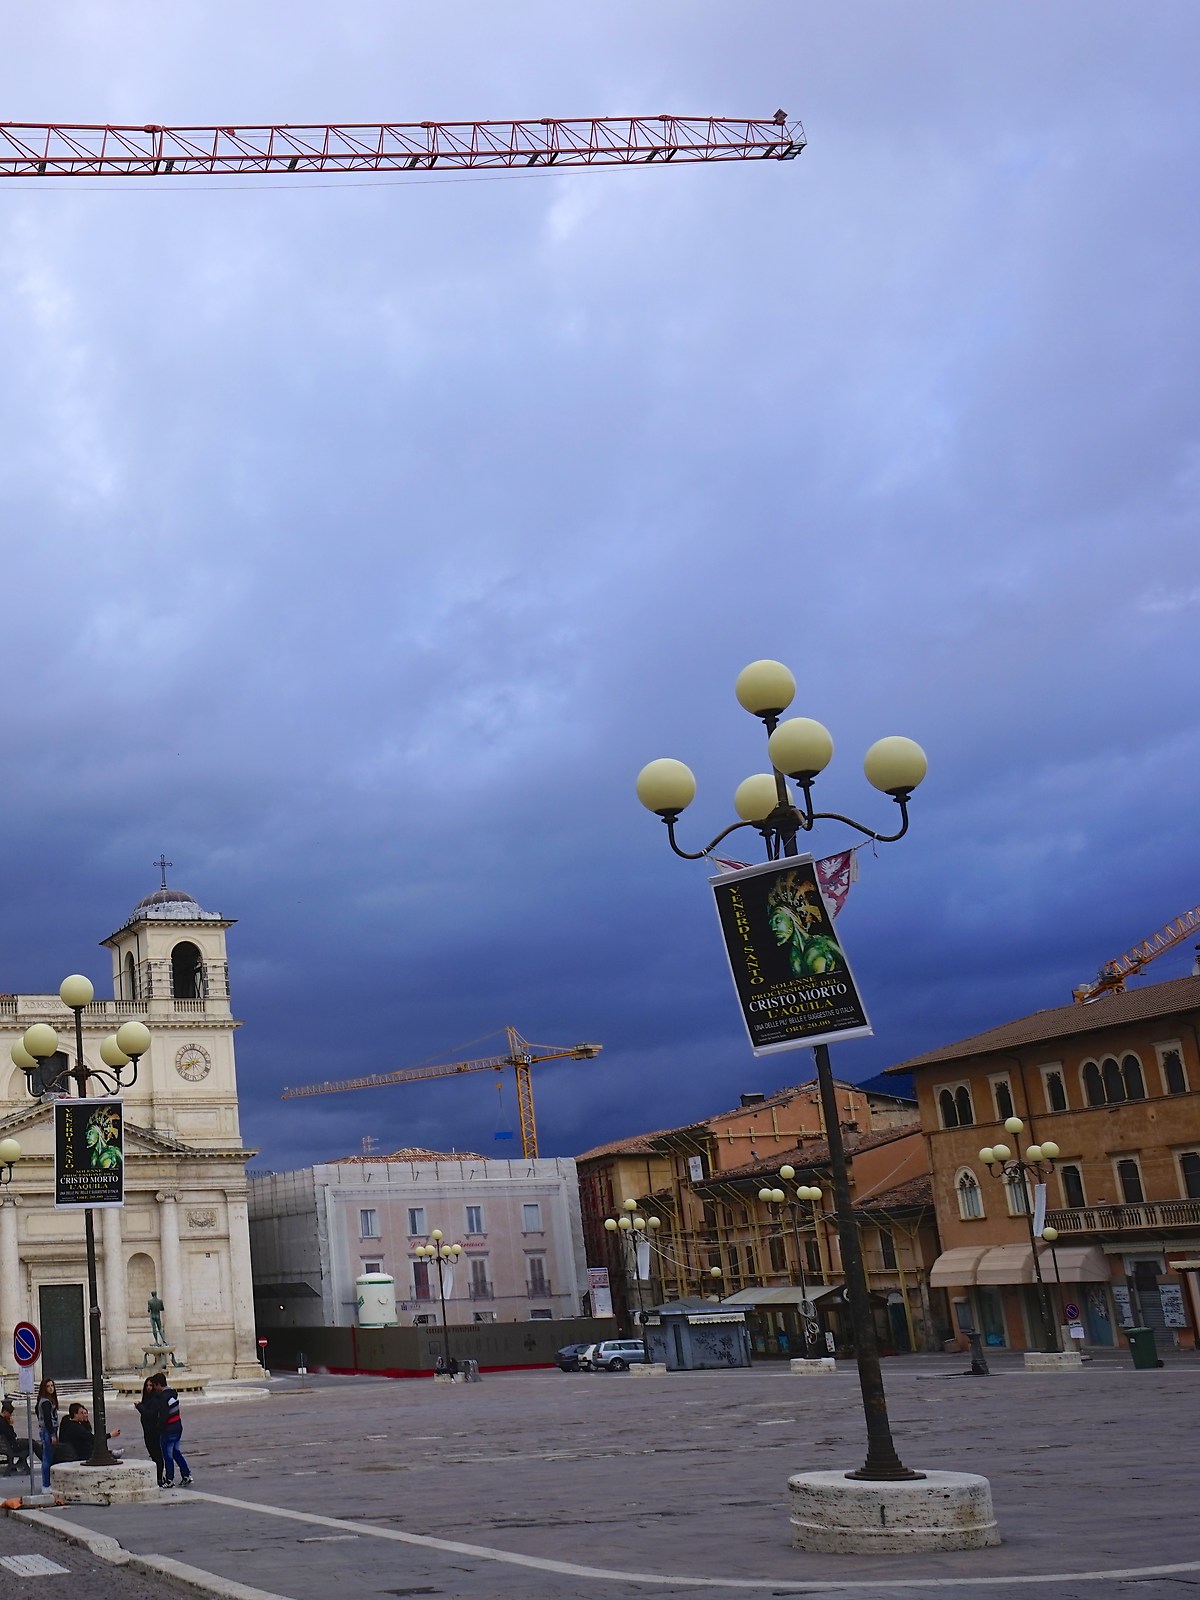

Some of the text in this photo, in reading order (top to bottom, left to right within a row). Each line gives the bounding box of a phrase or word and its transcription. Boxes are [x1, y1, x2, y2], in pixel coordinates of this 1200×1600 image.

[729, 886, 765, 985] VENERDI SANTO
[751, 978, 840, 1001] PROCESSIONE DEL
[770, 976, 817, 991] SOLENNE
[749, 983, 847, 1012] CRISTO MORTO
[767, 999, 834, 1019] L'AQUILA
[754, 1023, 765, 1031] UNA
[764, 1020, 780, 1029] DELLE
[789, 1016, 803, 1025] BELLE
[807, 1009, 836, 1021] SUGGESTIVE
[836, 1005, 856, 1016] D'ITALIA
[785, 1024, 806, 1034] ORE
[807, 1019, 831, 1030] 20.00
[64, 1144, 75, 1169] SANTO
[60, 1175, 119, 1185] CRISTO MORTO
